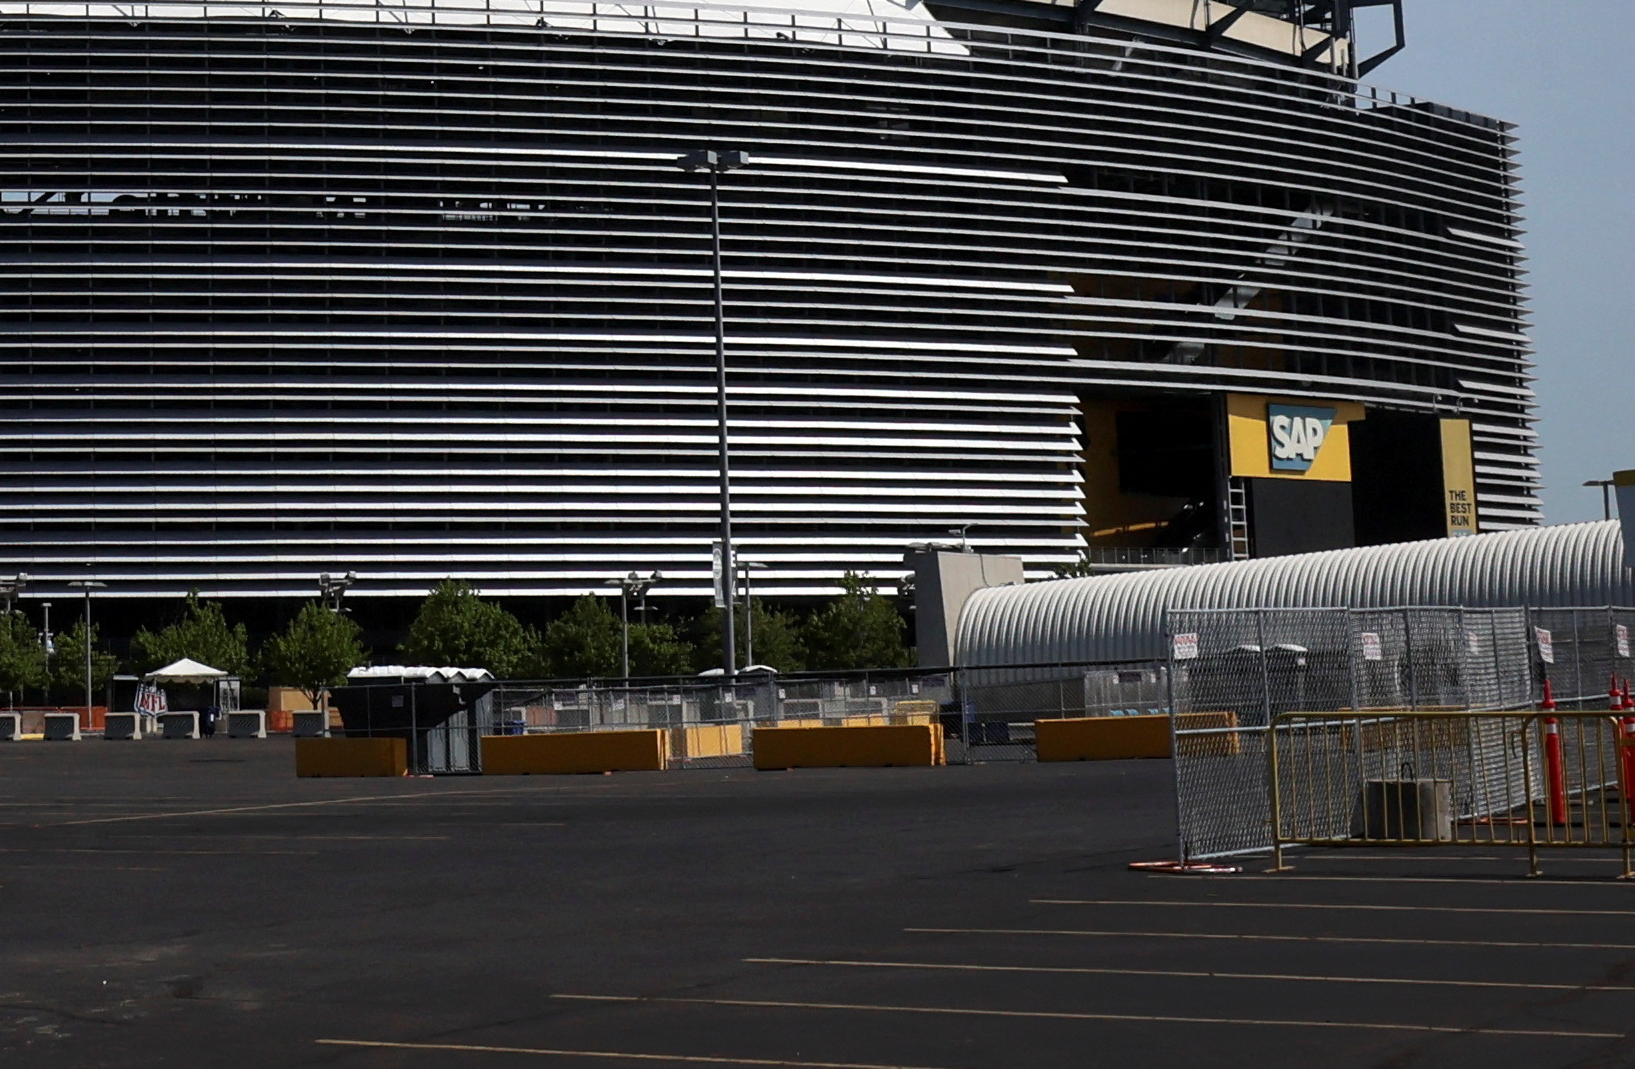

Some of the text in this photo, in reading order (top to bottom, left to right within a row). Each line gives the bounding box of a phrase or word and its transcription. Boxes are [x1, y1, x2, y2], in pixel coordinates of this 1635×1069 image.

[1272, 414, 1324, 460] SAP
[1449, 490, 1466, 500] THE
[1450, 503, 1472, 514] BEST
[1451, 515, 1470, 526] RUN
[141, 694, 166, 711] NFL
